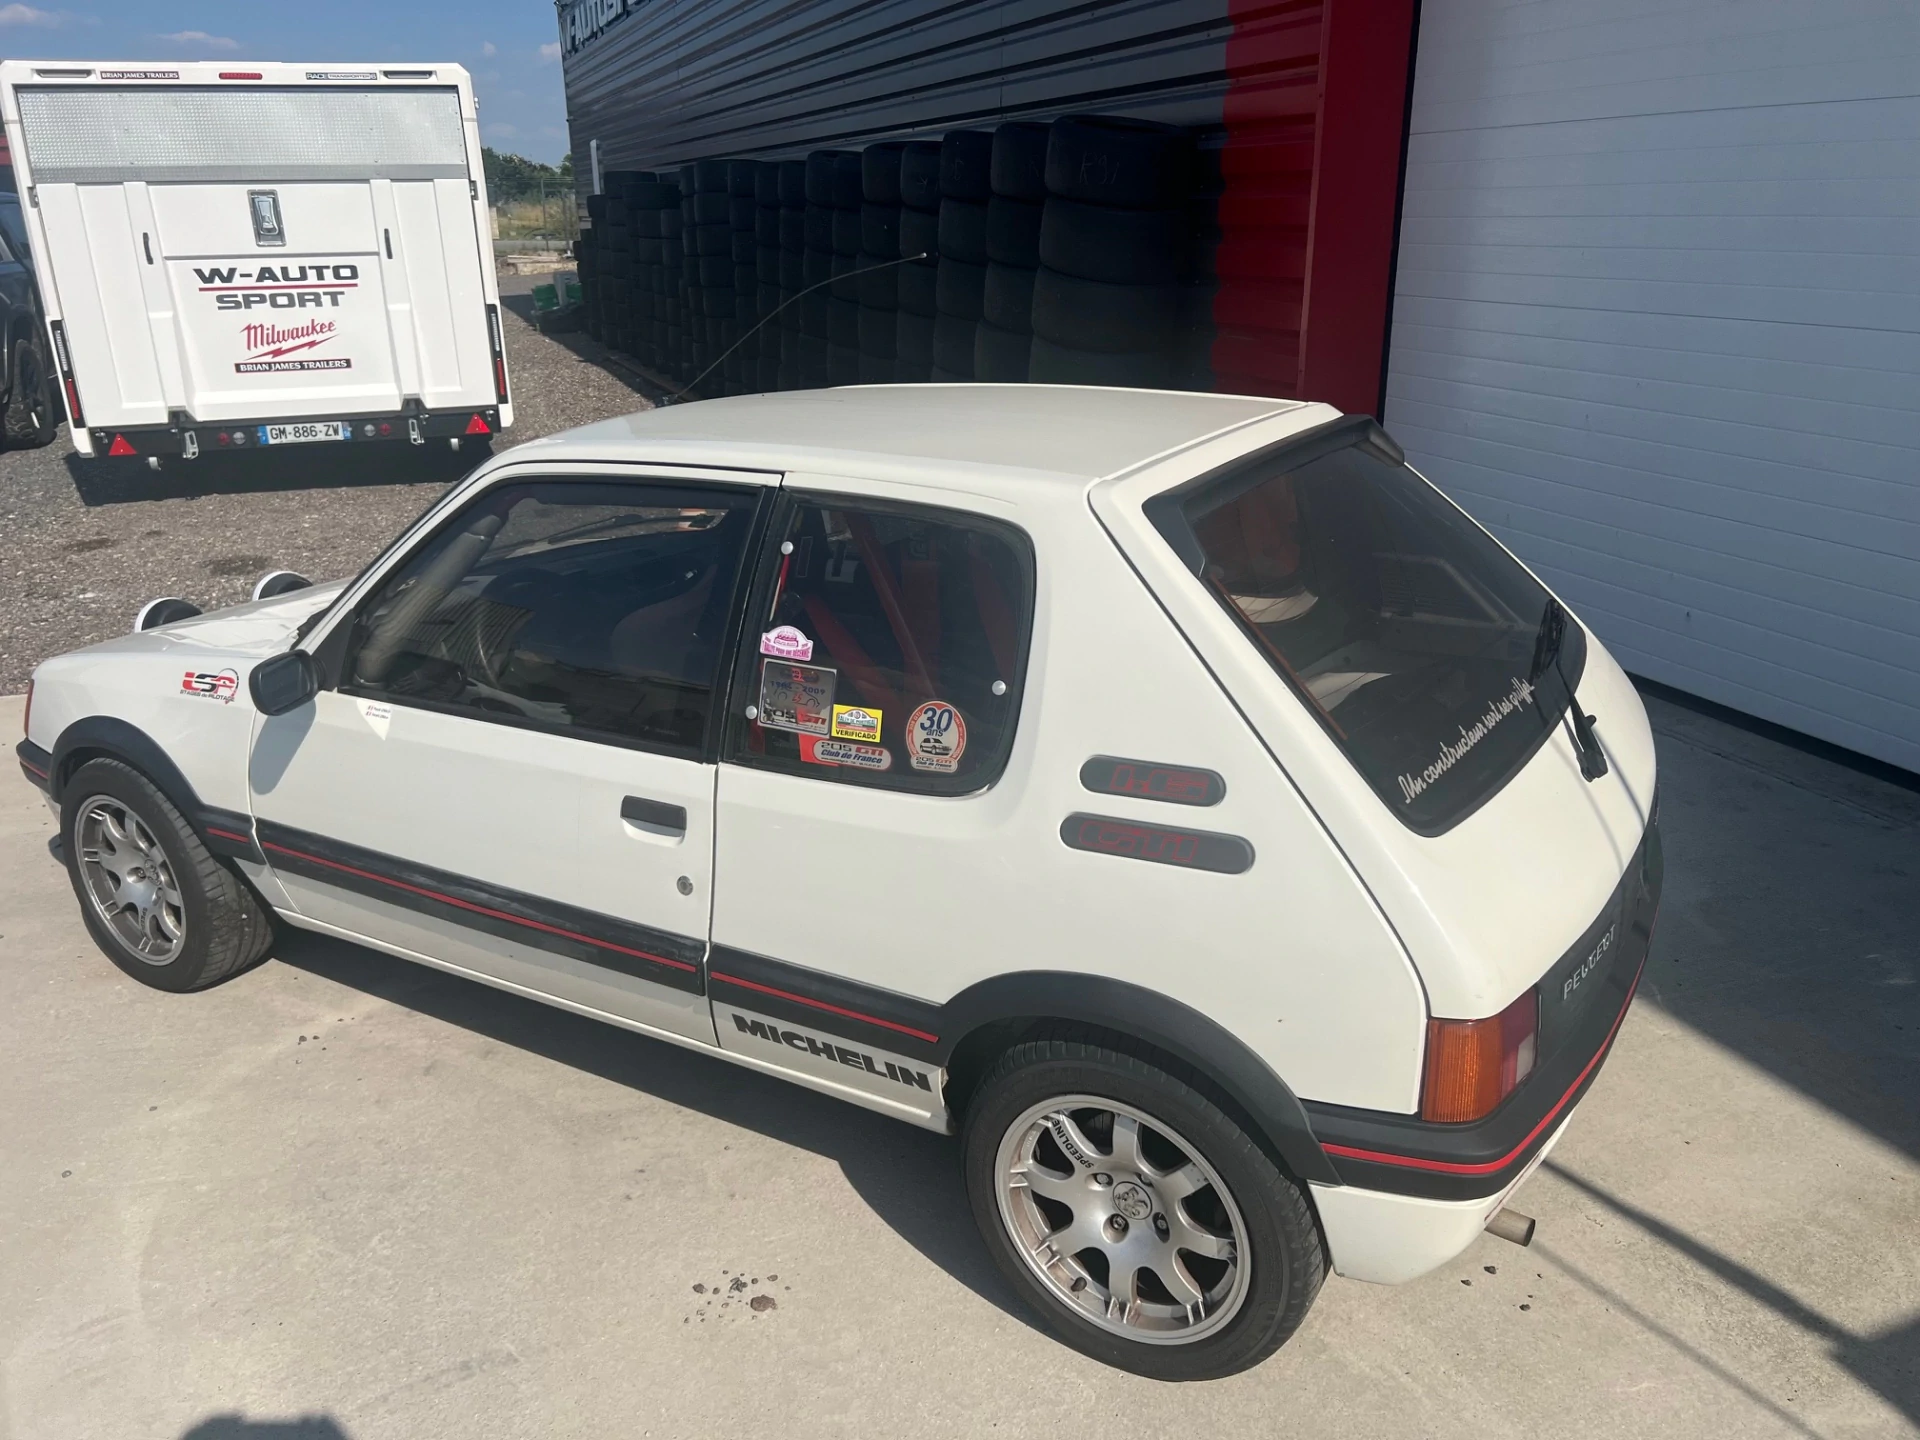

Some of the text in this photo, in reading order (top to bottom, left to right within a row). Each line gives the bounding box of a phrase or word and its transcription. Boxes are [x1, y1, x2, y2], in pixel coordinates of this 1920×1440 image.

[101, 71, 178, 79] BRIAN JAMES TRAILERS
[193, 264, 359, 284] W-AUTO
[215, 291, 345, 310] SPORT
[239, 319, 337, 351] Milwaukee
[240, 360, 347, 372] BRIAN JAMES TRAILERS
[270, 424, 339, 440] GM-886-ZW
[803, 686, 826, 695] 2009
[920, 707, 953, 732] 30
[835, 729, 876, 740] VERIFICADO
[926, 728, 943, 736] ans
[1424, 725, 1487, 783] constructeur
[1482, 701, 1502, 729] sort
[1497, 697, 1513, 715] ses
[821, 741, 884, 757] 205 GTI
[821, 749, 840, 757] Club
[841, 752, 852, 760] de
[1078, 820, 1199, 863] GTI
[1564, 923, 1616, 1000] PEUGEOT
[731, 1013, 932, 1092] MICHELIN
[1052, 1119, 1094, 1168] SPEEDLINE
